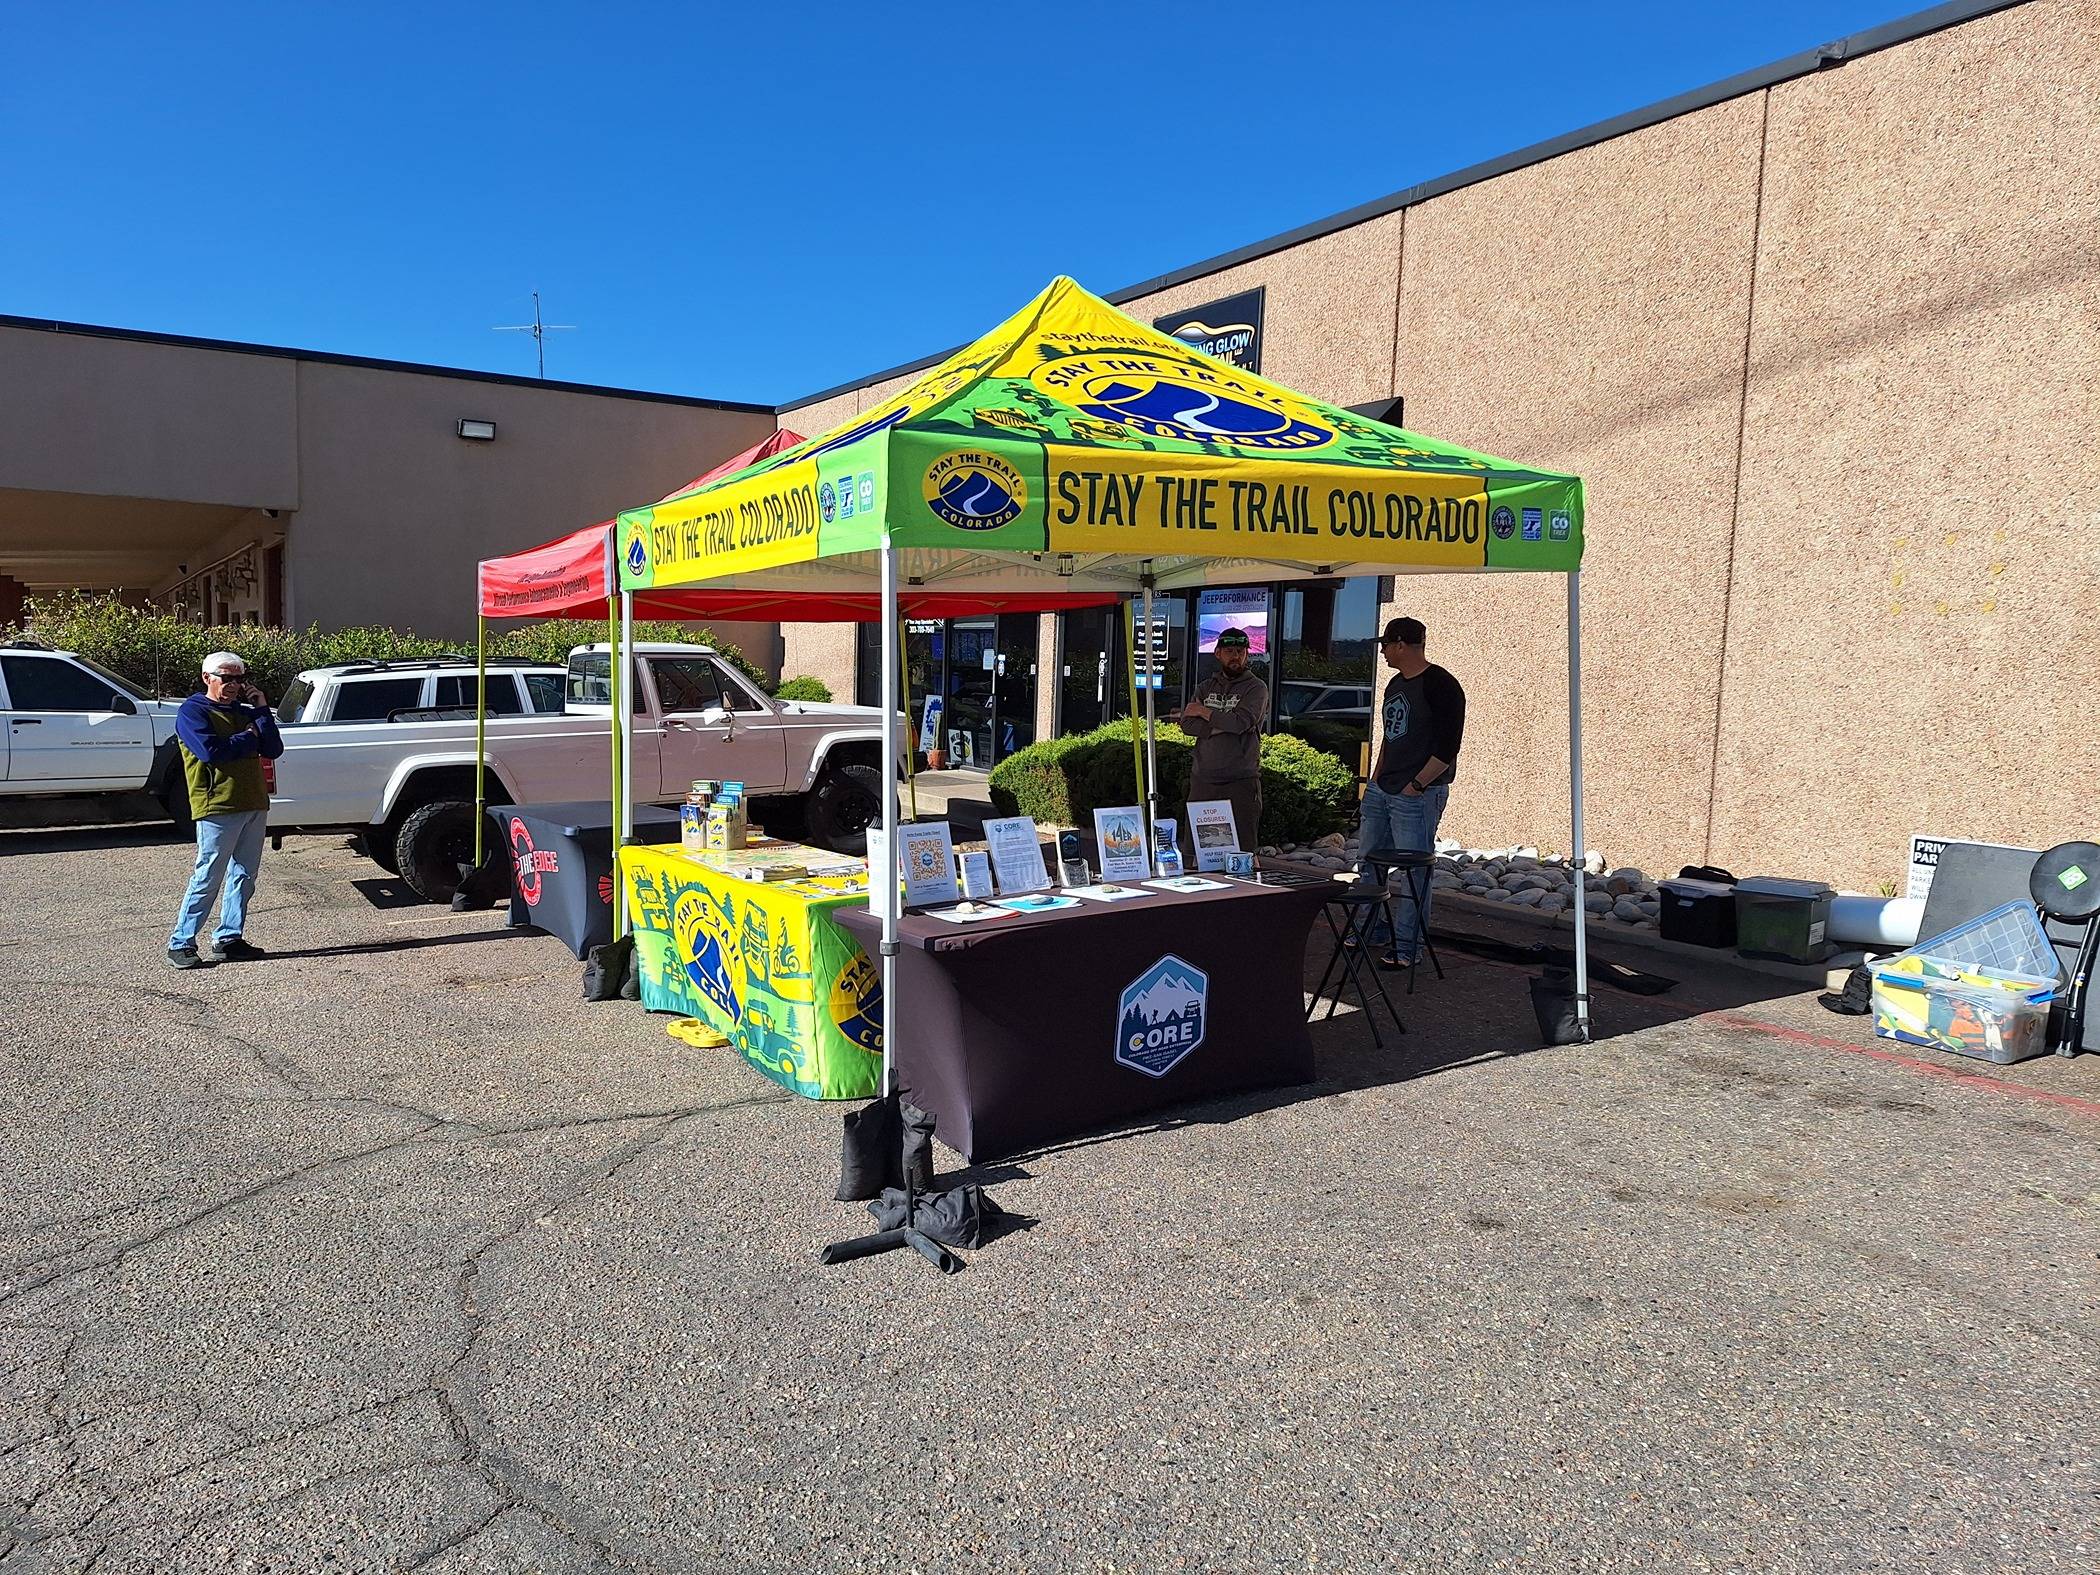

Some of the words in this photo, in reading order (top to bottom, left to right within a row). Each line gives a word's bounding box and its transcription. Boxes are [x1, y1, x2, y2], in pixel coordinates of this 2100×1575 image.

[1216, 331, 1250, 354] GLOW
[1045, 362, 1095, 387] STAY
[1098, 360, 1162, 373] THE
[1172, 365, 1285, 407] TRAIL
[1124, 416, 1321, 447] COLORADO
[929, 456, 954, 482] STAY
[958, 454, 982, 464] THE
[986, 456, 1021, 488] TRAIL
[941, 508, 1012, 528] COLORADO
[1057, 470, 1144, 526] STAY
[1156, 476, 1218, 530] THE
[1229, 480, 1318, 535] TRAIL
[1328, 488, 1480, 544] COLORADO
[654, 522, 680, 566] STAY
[682, 516, 702, 561] THE
[704, 507, 736, 557] TRAIL
[740, 484, 815, 549] COLORADO
[1202, 592, 1266, 604] JEEPERFORMANCE
[1003, 822, 1020, 830] CORE
[1196, 816, 1227, 824] CLOSURES!
[1914, 852, 1938, 864] PAR
[1916, 841, 1946, 854] PRIV
[518, 852, 534, 876] THE
[533, 850, 559, 872] EDGE
[693, 899, 708, 917] TE
[840, 956, 872, 993] STA
[1128, 1022, 1194, 1052] CORE
